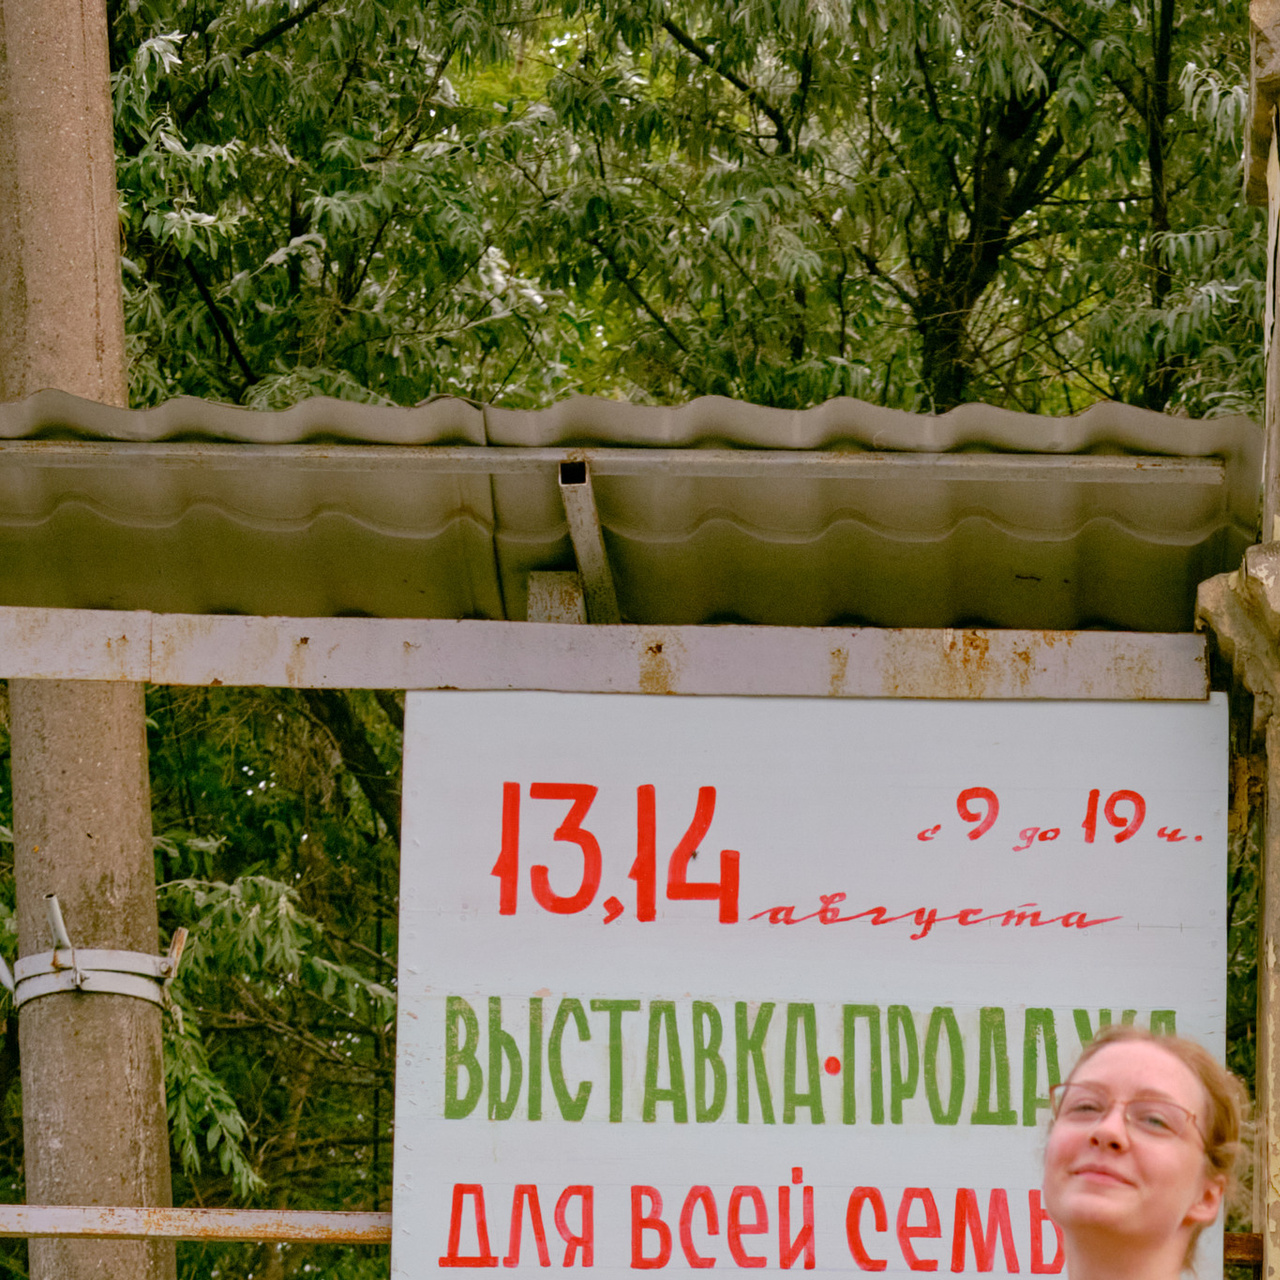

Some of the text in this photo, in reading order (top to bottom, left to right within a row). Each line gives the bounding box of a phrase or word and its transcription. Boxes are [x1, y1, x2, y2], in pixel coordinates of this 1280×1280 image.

[956, 786, 1000, 841] 9
[1012, 826, 1061, 852] до
[1081, 787, 1147, 845] 19
[748, 892, 1123, 941] августа
